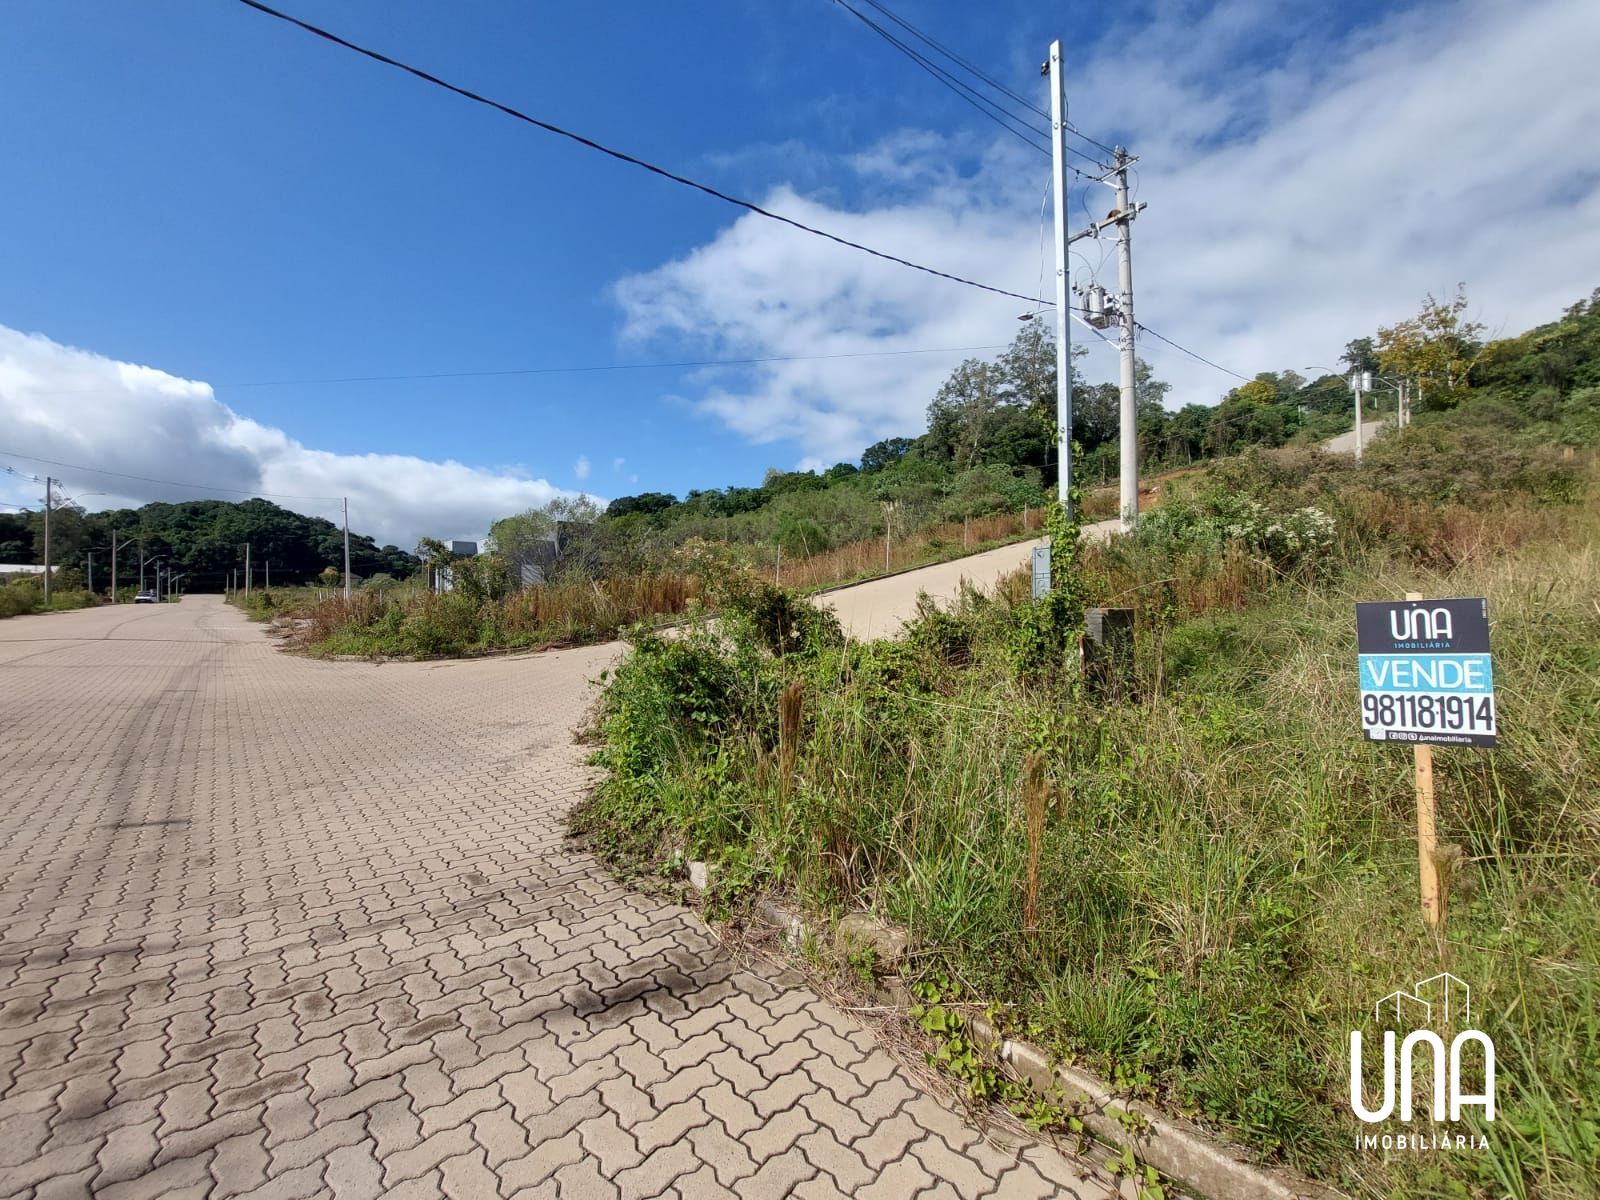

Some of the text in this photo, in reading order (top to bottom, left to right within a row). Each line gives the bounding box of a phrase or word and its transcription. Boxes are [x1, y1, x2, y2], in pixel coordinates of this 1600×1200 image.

[1390, 607, 1453, 640] UNA
[1394, 641, 1451, 649] IMOBILIÁRIA
[1366, 659, 1485, 689] VENDE
[1363, 693, 1493, 731] 981181914
